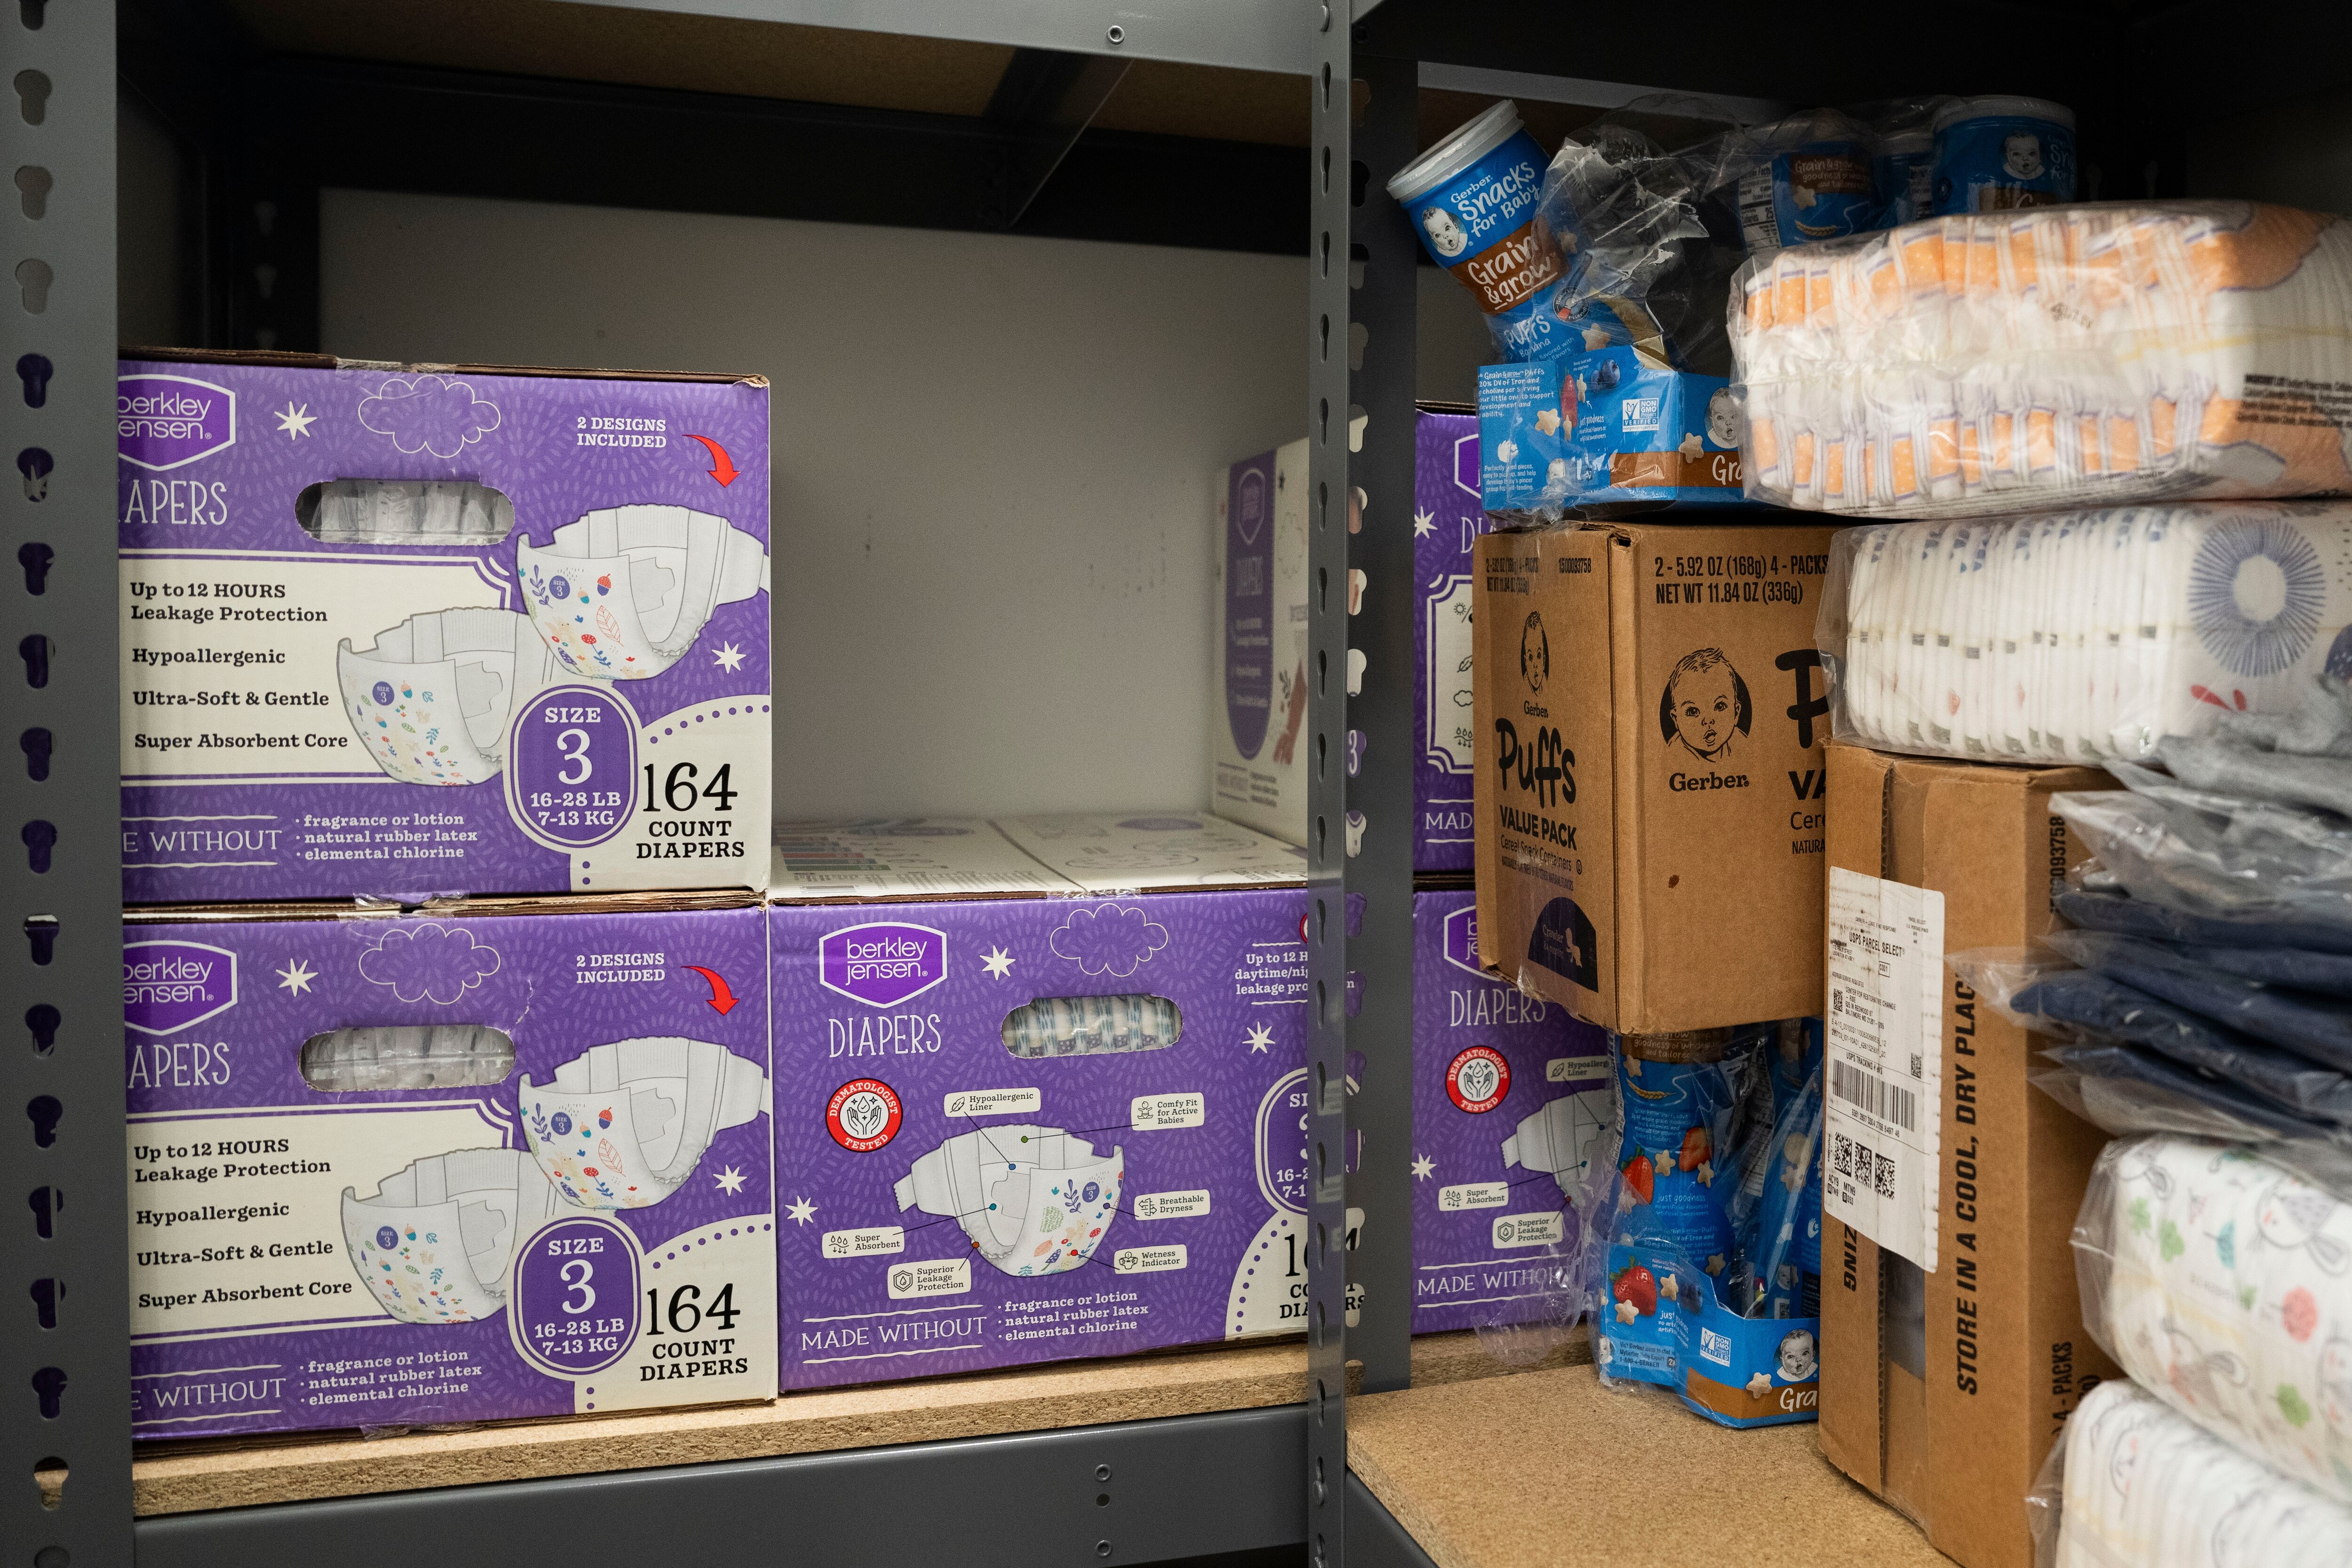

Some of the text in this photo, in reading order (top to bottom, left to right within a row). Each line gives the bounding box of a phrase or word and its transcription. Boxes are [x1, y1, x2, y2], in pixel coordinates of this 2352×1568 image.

[1451, 175, 1491, 203] Gerber
[1457, 162, 1535, 221] Snacks
[1471, 183, 1541, 237] for Baby
[1468, 236, 1540, 286] Grain
[119, 420, 204, 439] ensen
[578, 417, 667, 432] 2 DESIGNS
[577, 433, 667, 448] INCLUDED
[123, 480, 228, 525] APERS
[1558, 557, 1591, 574] 1500093758
[1655, 554, 1829, 579] 2 5.92 OZ (168g) 4 PACKS
[130, 582, 286, 600] Up to 12 HOURS
[556, 586, 563, 596] 3
[1656, 580, 1803, 605] NET WT 11.84 OZ (336g)
[131, 605, 328, 624] Leakage Protection
[132, 648, 286, 668] Hypoallergenic
[133, 691, 330, 706] Ultra-Soft & Gentle
[545, 707, 601, 724] SIZE
[1523, 700, 1549, 718] Gerber
[135, 733, 348, 751] Super Absorbent Core
[556, 728, 593, 785] 3
[1495, 717, 1577, 809] Puffs
[643, 762, 739, 812] 164
[1669, 772, 1747, 793] Gerber
[531, 792, 622, 808] 16-28 LB
[303, 813, 464, 830] fragrance or lotion
[538, 811, 615, 826] 7-13 KG
[1499, 804, 1578, 852] VALUE PACK
[304, 830, 478, 844] natural rubber latex
[648, 820, 732, 837] COUNT
[150, 830, 283, 852] WITHOUT
[636, 841, 745, 860] DIAPERS
[1791, 840, 1826, 855] NATURA
[304, 846, 464, 860] elemental chlorine
[847, 937, 928, 961] berkley
[1849, 931, 1861, 945] USPS
[1862, 936, 1881, 952] PARCEL
[1246, 953, 1263, 966] Up
[1266, 952, 1280, 964] to
[1283, 952, 1296, 963] 12
[124, 985, 206, 1003] ensen
[1236, 983, 1285, 995] leakage
[1845, 986, 1857, 996] CENTER
[1882, 999, 1896, 1011] CHANGE
[828, 1013, 941, 1059] DIAPERS
[1448, 1049, 1508, 1082] DERMATOLOGIST
[1846, 1051, 1873, 1070] USPS TRACKING
[829, 1082, 898, 1118] DERMATOLOGIST
[969, 1091, 1034, 1104] Hypoallergenic
[1955, 1063, 1976, 1125] DRY
[969, 1102, 993, 1112] Liner
[1158, 1099, 1198, 1111] Comfy Fit
[1158, 1107, 1199, 1117] for Active
[1461, 1097, 1499, 1112] TESTED
[1158, 1116, 1184, 1125] Babies
[844, 1133, 889, 1151] TESTED
[1955, 1135, 1979, 1223] COOL,
[1159, 1195, 1204, 1206] Breathable
[1466, 1188, 1488, 1197] Super
[1466, 1194, 1505, 1204] Absorbent
[1160, 1204, 1193, 1214] Dryness
[548, 1237, 604, 1256] SIZE
[855, 1234, 881, 1243] Super
[855, 1241, 900, 1251] Absorbent
[1956, 1233, 1977, 1252] A
[1142, 1250, 1176, 1259] Wetness
[1142, 1257, 1180, 1267] Indicator
[917, 1266, 954, 1275] Superior
[917, 1273, 953, 1283] Leakage
[1956, 1257, 1977, 1292] IN
[560, 1258, 596, 1314] 3
[917, 1280, 964, 1291] Protection
[1417, 1274, 1476, 1296] MADE
[646, 1282, 741, 1336] 164
[535, 1318, 626, 1339] 16-28 LB
[801, 1316, 987, 1351] MADE WITHOUT
[542, 1337, 619, 1356] 7-13 KG
[652, 1338, 736, 1359] COUNT
[1715, 1342, 1729, 1351] GMO
[1716, 1337, 1729, 1345] NON
[1956, 1297, 1978, 1396] STORE
[1701, 1345, 1729, 1361] VERIFIED
[640, 1358, 749, 1382] DIAPERS
[2052, 1342, 2072, 1395] PACKS
[153, 1378, 287, 1408] WITHOUT
[1780, 1387, 1818, 1412] Gra
